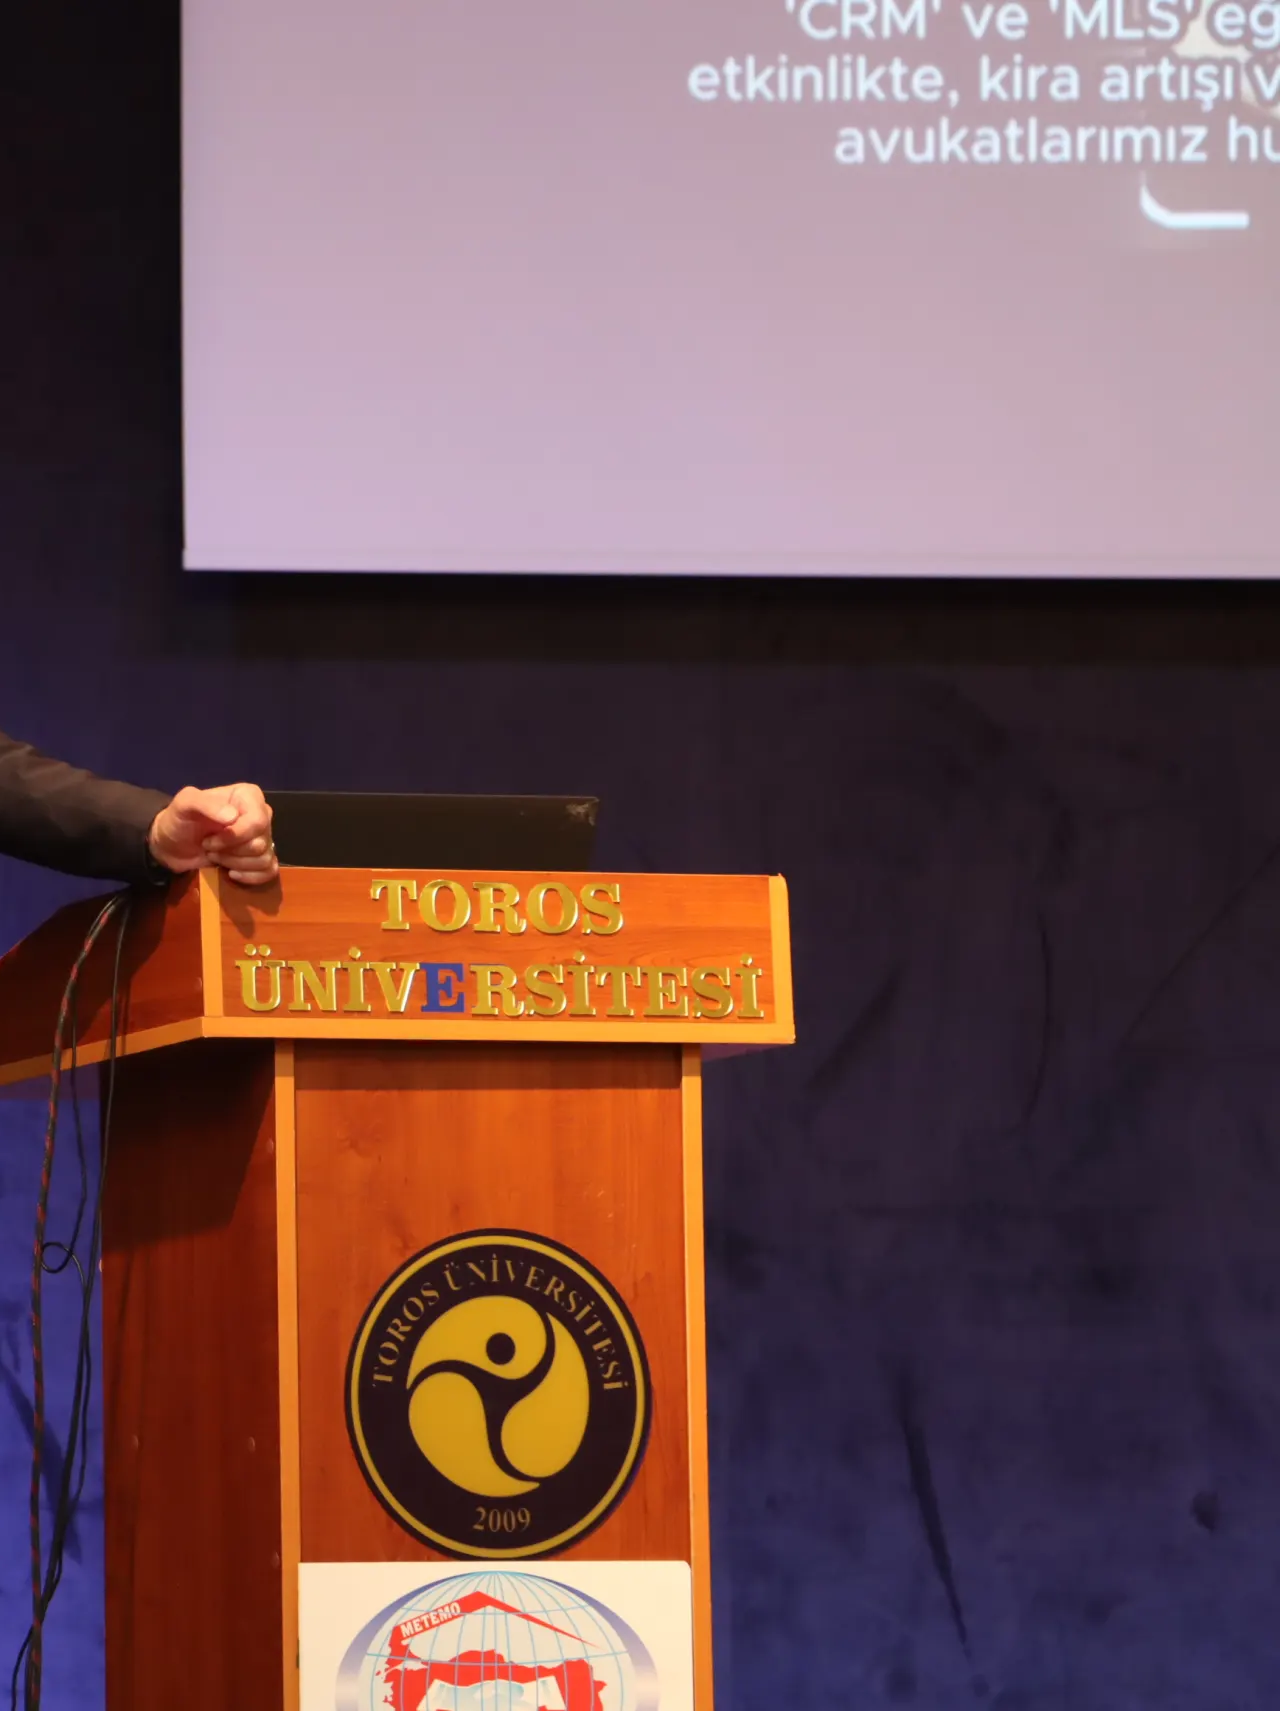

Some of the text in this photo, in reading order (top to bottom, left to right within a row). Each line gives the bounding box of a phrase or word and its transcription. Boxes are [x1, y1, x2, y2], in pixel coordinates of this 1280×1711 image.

[785, 0, 941, 40] 'CRM'
[962, 0, 1029, 40] ve
[1049, 0, 1192, 40] 'MLS'
[688, 54, 960, 107] etkinlikte,
[979, 56, 1080, 101] kira
[1100, 56, 1234, 112] artışı
[835, 117, 1208, 165] avukatlarımız
[370, 878, 624, 936] TOROS
[234, 943, 765, 1019] ÜNİVERSİTESİ
[372, 1253, 629, 1391] TOROS ÜNİVERSİTESİ
[472, 1506, 531, 1533] 2009
[399, 1602, 461, 1639] METEMO
